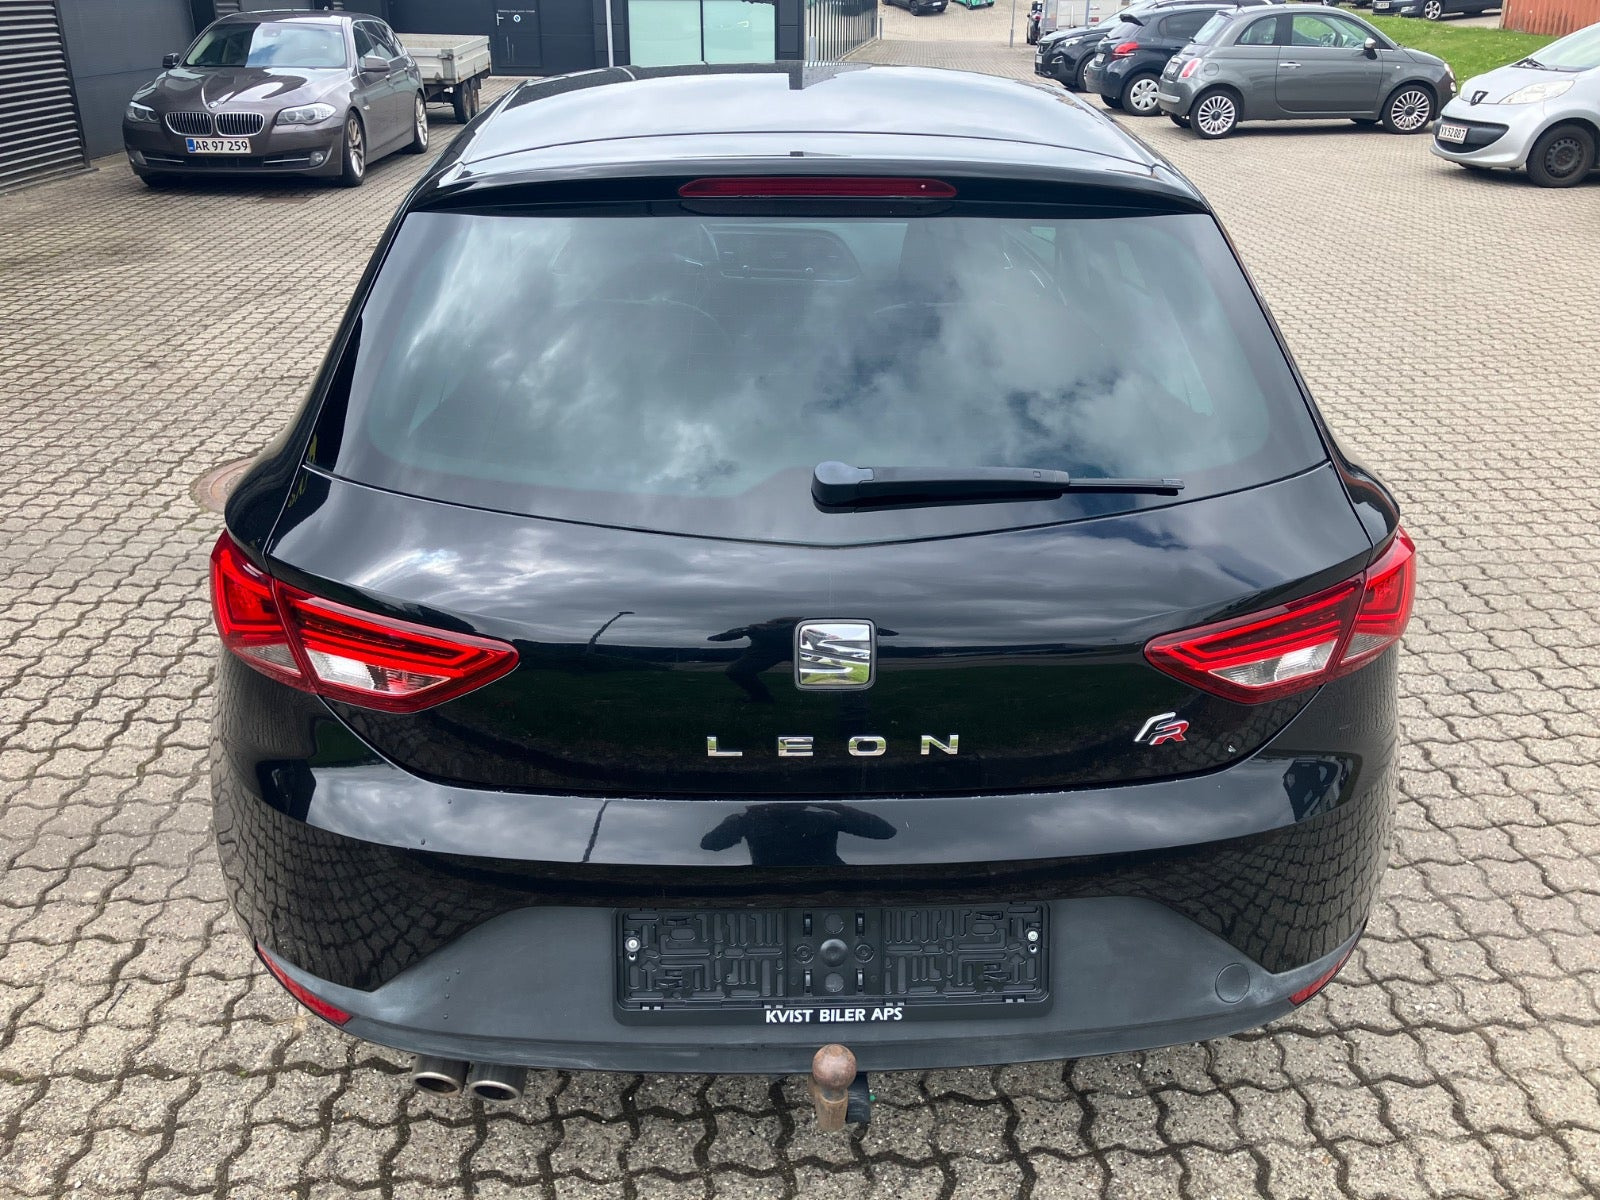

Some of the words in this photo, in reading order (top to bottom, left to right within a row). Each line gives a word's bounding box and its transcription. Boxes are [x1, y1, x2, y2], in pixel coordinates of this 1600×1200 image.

[195, 140, 210, 151] AR
[211, 140, 224, 151] 97
[227, 140, 248, 151] 259
[1134, 711, 1189, 745] FR
[706, 734, 959, 757] LEON
[765, 1009, 813, 1023] KVIST
[819, 1008, 866, 1022] BILER
[871, 1007, 903, 1021] APS
